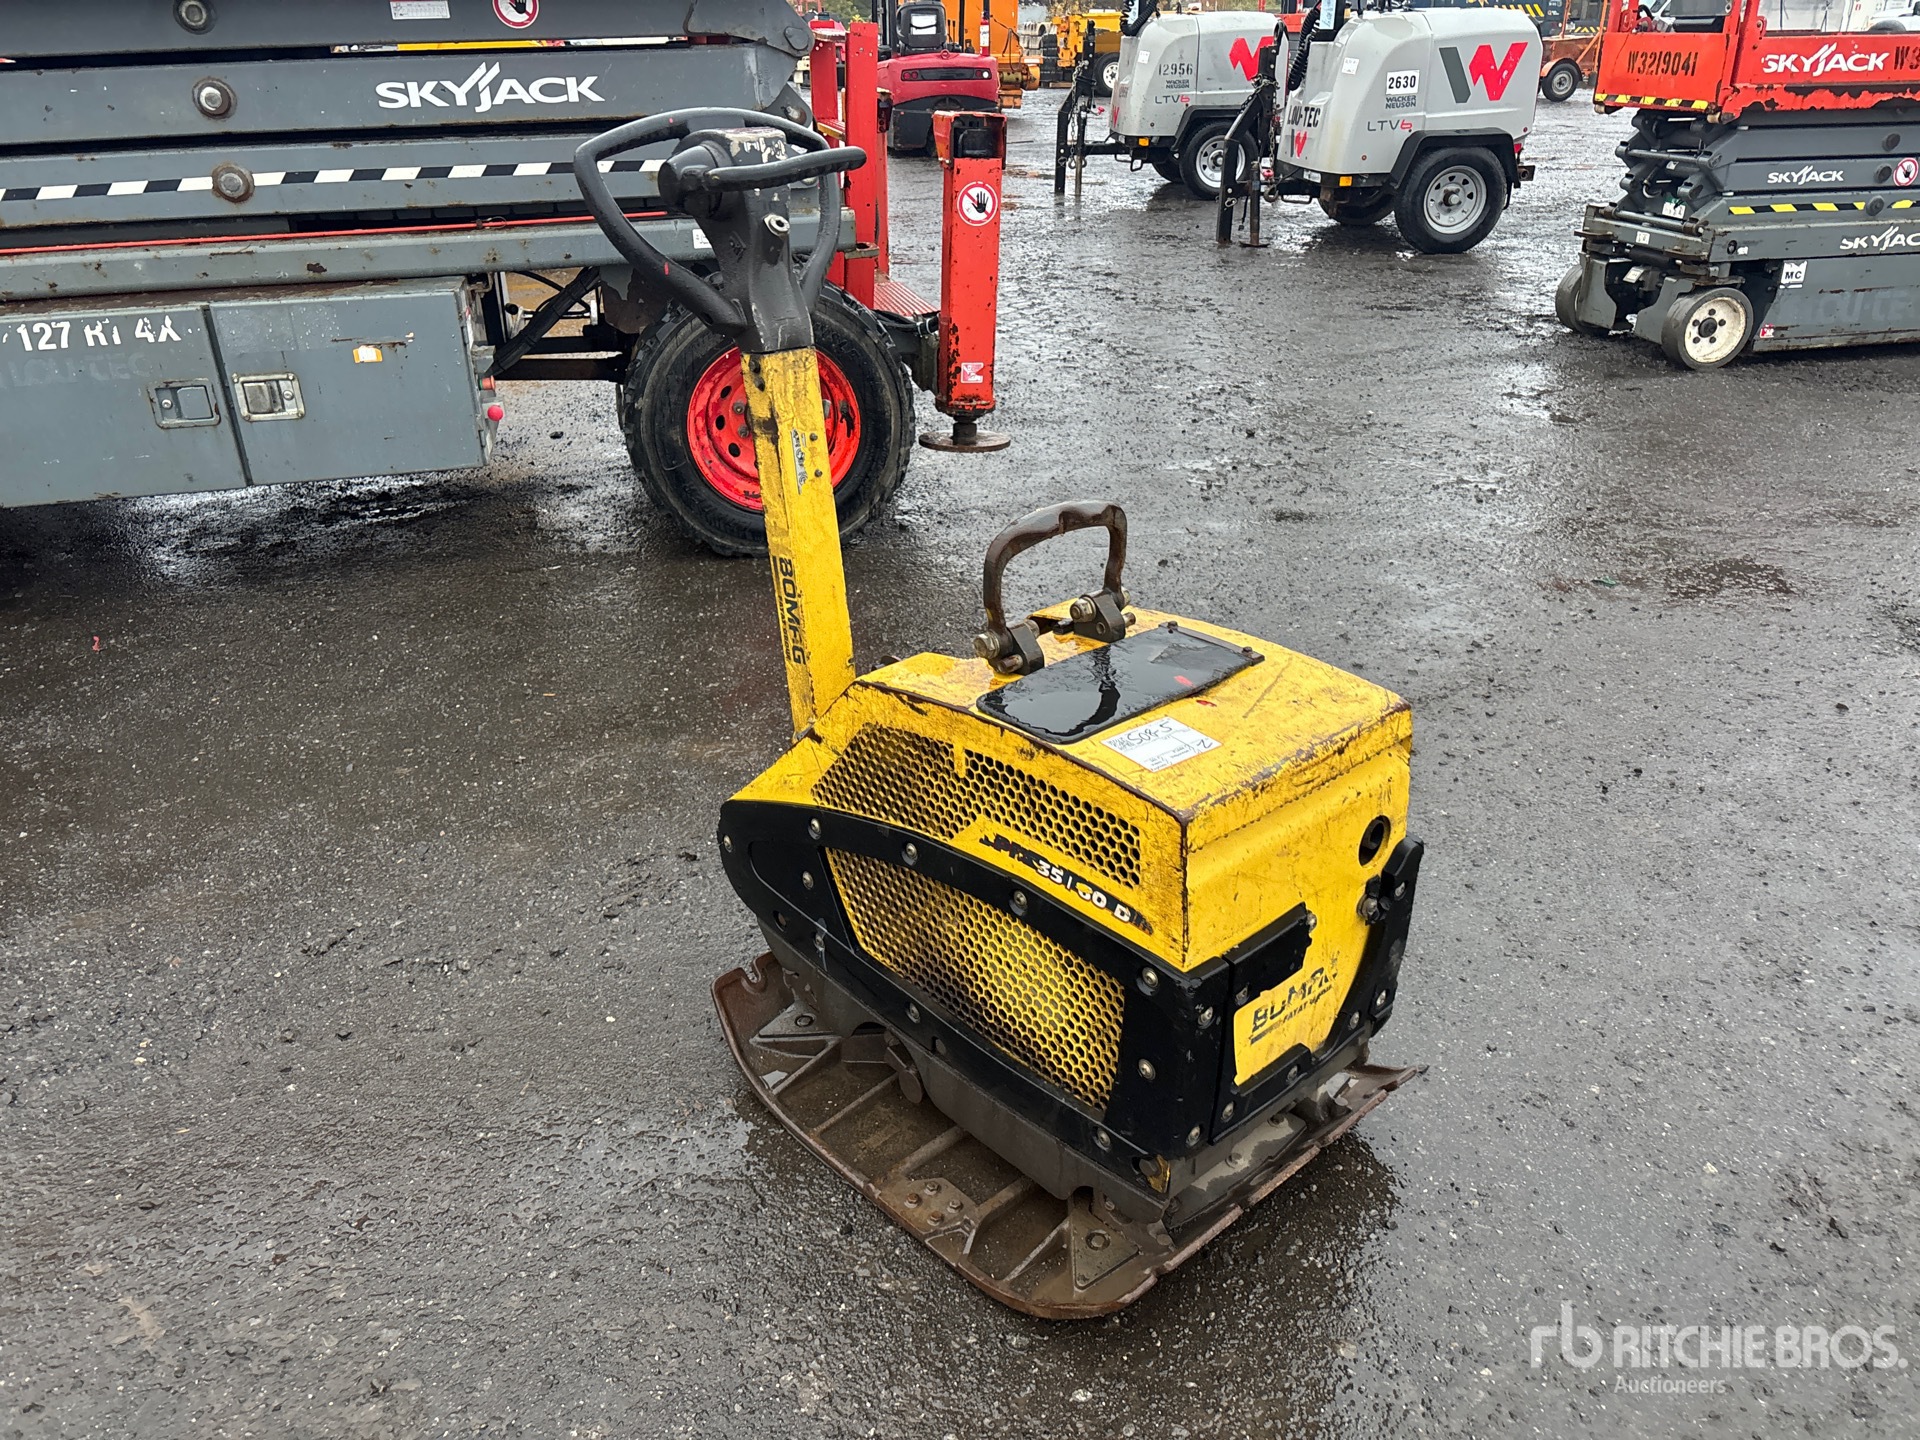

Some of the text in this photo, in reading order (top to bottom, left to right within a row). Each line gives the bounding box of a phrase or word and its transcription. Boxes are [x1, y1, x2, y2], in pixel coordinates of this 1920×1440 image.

[1761, 42, 1890, 77] SKYJACK
[1158, 63, 1193, 76] 12956
[375, 62, 605, 112] SKYJACK
[1388, 75, 1416, 89] 2630
[1155, 94, 1190, 104] LTV6
[1385, 95, 1417, 103] WACKER
[1287, 105, 1321, 128] LOU-TEC
[1367, 119, 1413, 131] LTV6
[1767, 165, 1844, 186] SKYJACK
[1784, 271, 1802, 280] MC
